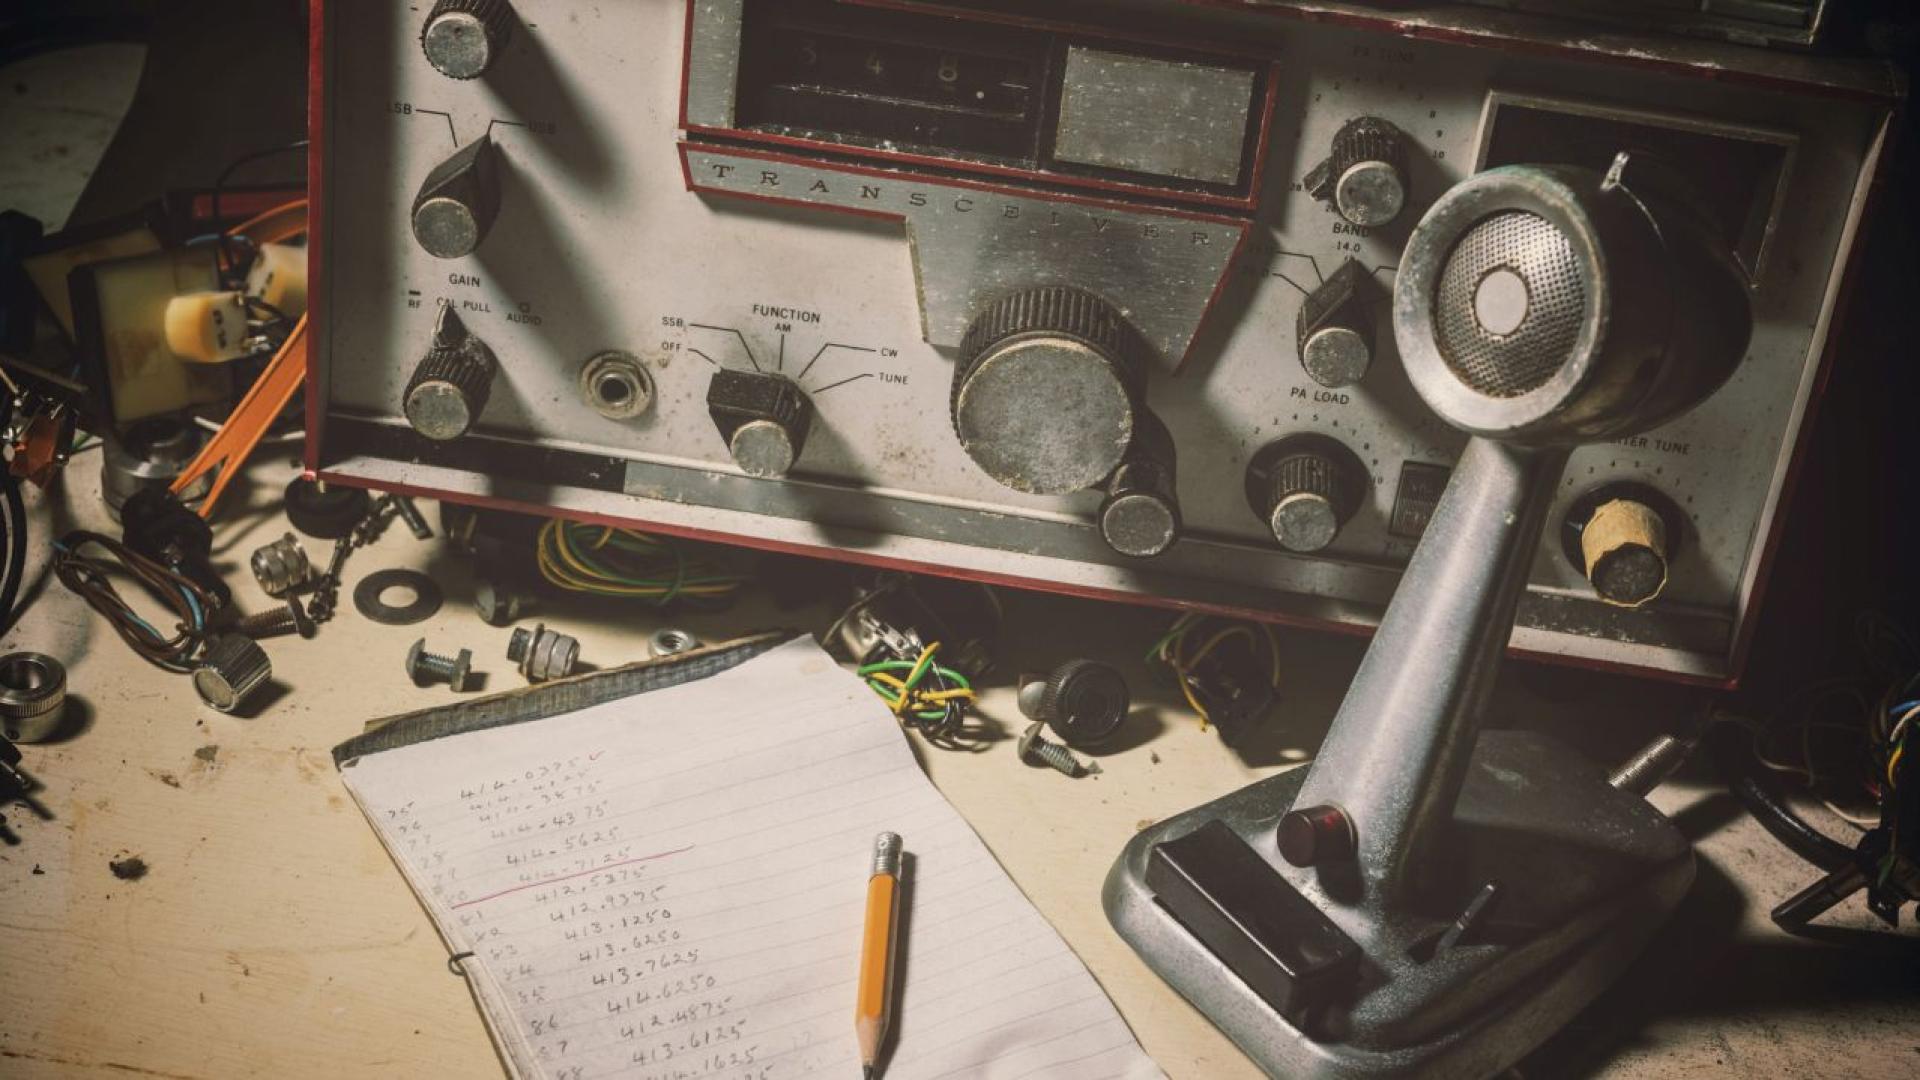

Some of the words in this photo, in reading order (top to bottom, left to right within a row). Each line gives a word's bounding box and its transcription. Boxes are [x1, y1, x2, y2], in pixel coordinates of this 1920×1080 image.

[711, 163, 1211, 245] TRANSCEIVER
[448, 272, 481, 288] GAIN
[408, 298, 422, 309] RF
[463, 299, 492, 313] PULL
[506, 312, 542, 326] AUDIO
[752, 303, 822, 324] FUNCTION
[661, 316, 684, 328] SSB
[774, 322, 792, 333] AM
[661, 341, 682, 353] OFF
[880, 346, 899, 358] CW
[878, 371, 909, 385] TUNE
[1289, 386, 1308, 399] PA
[1313, 390, 1350, 405] LOAD
[1654, 438, 1691, 456] TUNE
[592, 947, 700, 986] 413.7625
[606, 973, 717, 1014] 414.6250
